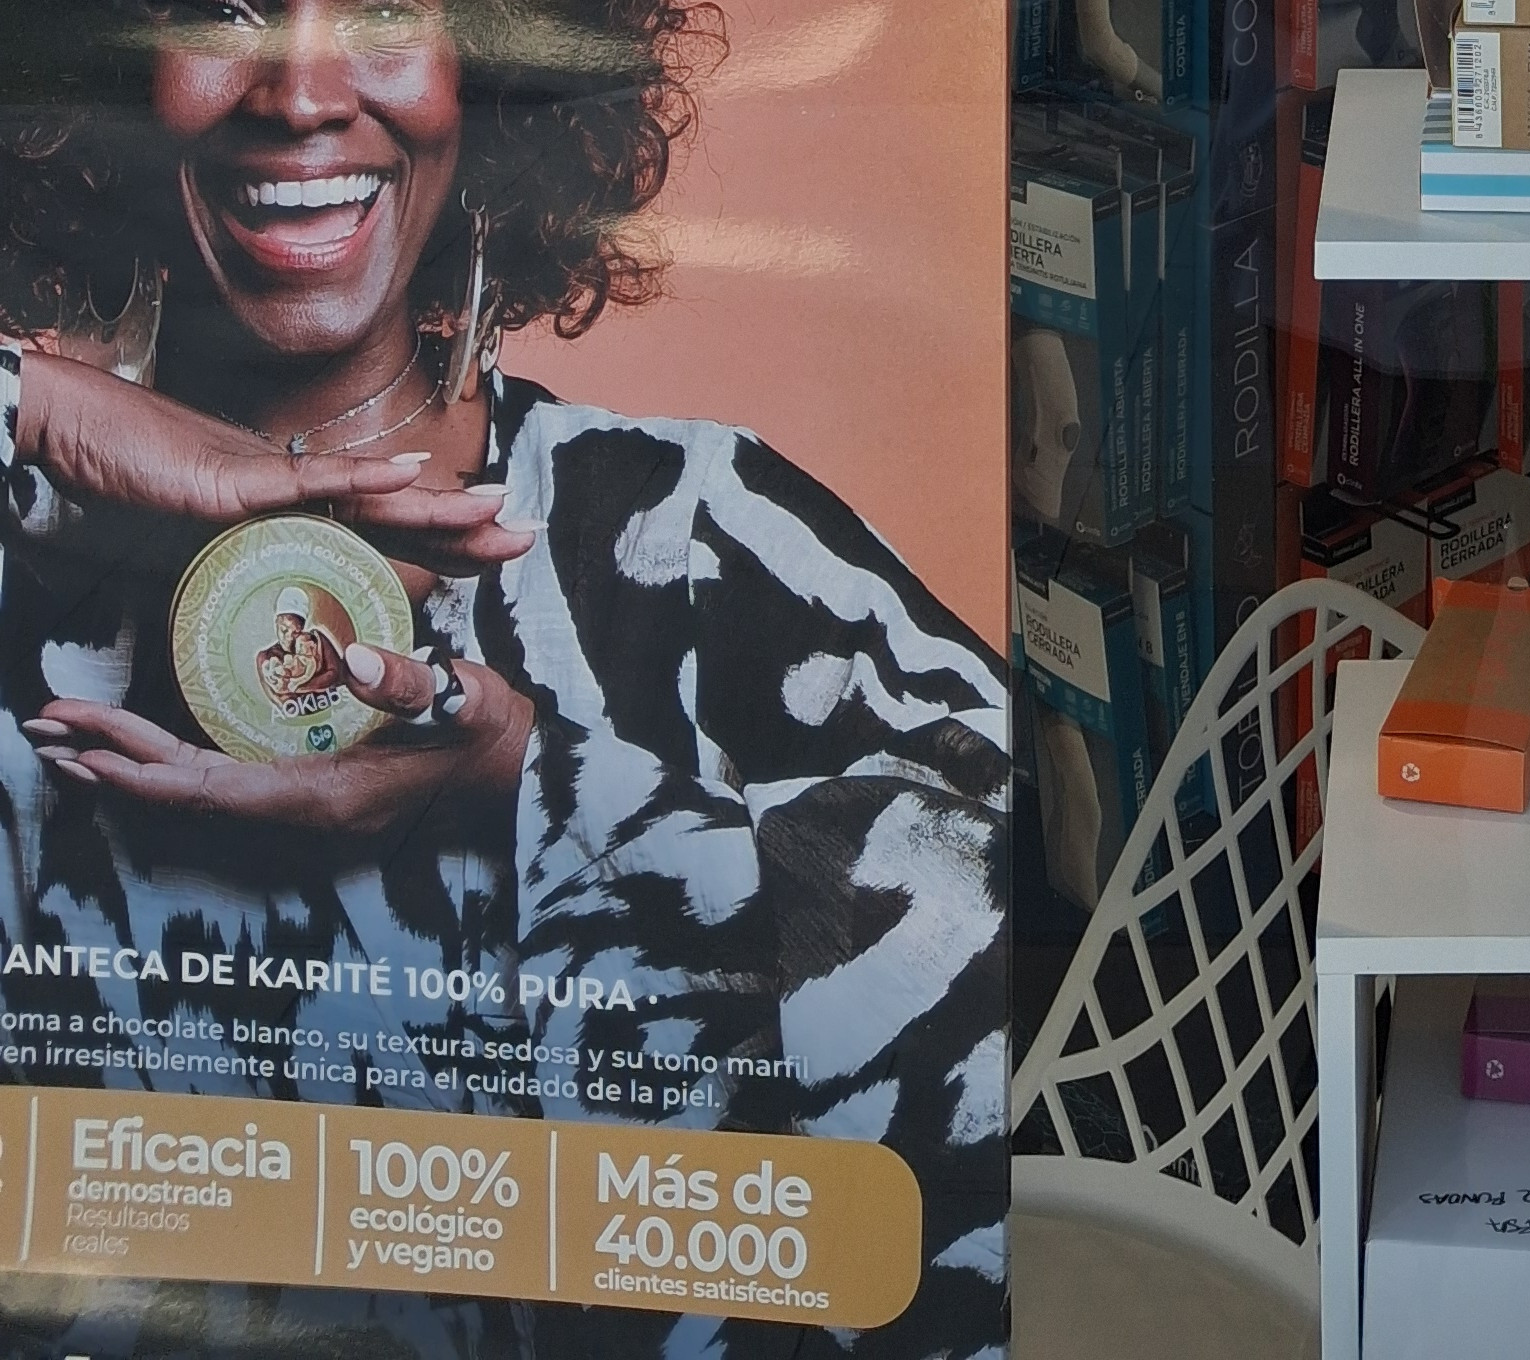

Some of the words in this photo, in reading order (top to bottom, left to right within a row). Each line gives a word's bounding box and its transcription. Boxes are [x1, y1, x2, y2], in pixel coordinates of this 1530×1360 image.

[1176, 14, 1187, 78] CODERA
[1355, 302, 1365, 334] ONE
[1233, 237, 1261, 460] RODILLA
[1354, 335, 1364, 353] IN
[1114, 356, 1125, 416] ABIERTA
[1353, 355, 1363, 385] ALL
[1350, 387, 1362, 467] RODILLERA
[1116, 418, 1128, 508] RODILLERA
[1440, 512, 1513, 557] RODILLERA
[1440, 533, 1505, 570] CERRADA
[1026, 614, 1082, 659] RODILLERA
[1026, 630, 1075, 670] CERRADA
[1178, 643, 1192, 706] VENDAJE
[271, 684, 350, 722] AOKlabs
[311, 725, 332, 747] bio
[0, 943, 169, 982] ANTECA
[181, 951, 235, 986] DE
[248, 956, 393, 997] KARITÉ
[403, 966, 506, 1005] 100%
[518, 973, 636, 1012] PURA
[0, 1013, 61, 1032] oma
[69, 1016, 84, 1033] a
[92, 1011, 224, 1041] chocolate
[232, 1018, 330, 1052] blanco,
[338, 1031, 368, 1051] su
[376, 1029, 476, 1059] textura
[483, 1040, 580, 1067] sedosa
[587, 1049, 605, 1073] y
[611, 1049, 644, 1070] su
[653, 1049, 719, 1074] tono
[726, 1056, 810, 1080] marfil
[45, 1039, 275, 1079] irresistiblemente
[283, 1056, 357, 1084] única
[366, 1065, 426, 1093] para
[434, 1064, 459, 1091] el
[466, 1070, 579, 1100] cuidado
[586, 1077, 622, 1103] de
[630, 1079, 655, 1104] la
[662, 1083, 721, 1111] piel.
[73, 1116, 292, 1180] Eficacia
[67, 1173, 233, 1207] demostrada
[349, 1139, 520, 1210] 100%
[597, 1152, 720, 1212] Más
[732, 1160, 813, 1218] de
[65, 1202, 191, 1231] Resultados
[349, 1204, 504, 1242] ecológico
[63, 1229, 130, 1256] reales
[346, 1240, 370, 1271] y
[374, 1240, 495, 1274] vegano
[594, 1213, 808, 1280] 40.000
[594, 1266, 688, 1298] clientes
[692, 1277, 831, 1310] satisfechos
